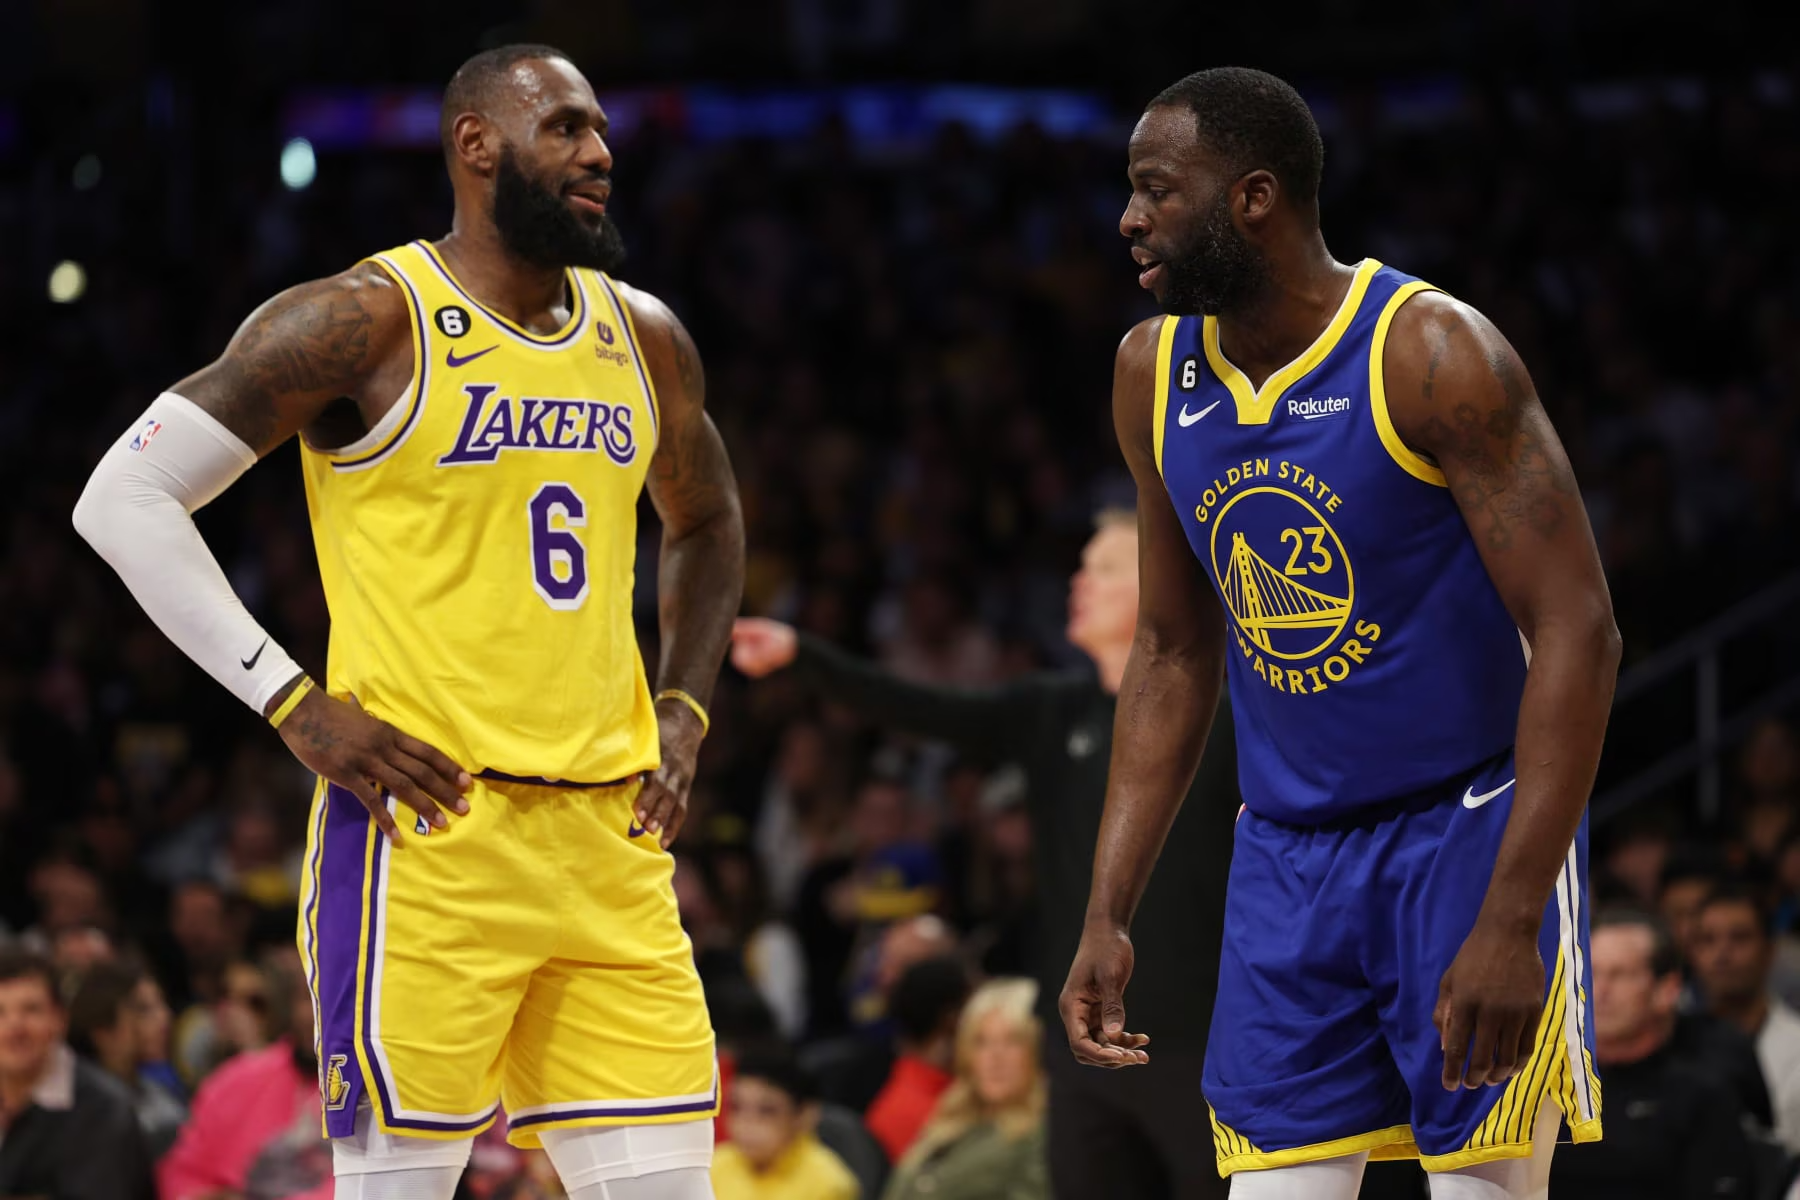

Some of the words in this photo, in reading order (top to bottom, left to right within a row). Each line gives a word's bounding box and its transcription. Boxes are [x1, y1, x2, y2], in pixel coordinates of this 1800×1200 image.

[441, 309, 464, 335] 6
[1182, 359, 1196, 389] 6
[1288, 397, 1350, 417] Rakuten
[1195, 458, 1269, 523] GOLDEN
[1278, 461, 1343, 514] STATE
[528, 482, 589, 610] 6
[1280, 526, 1333, 576] 23
[1233, 619, 1381, 694] WARRIORS
